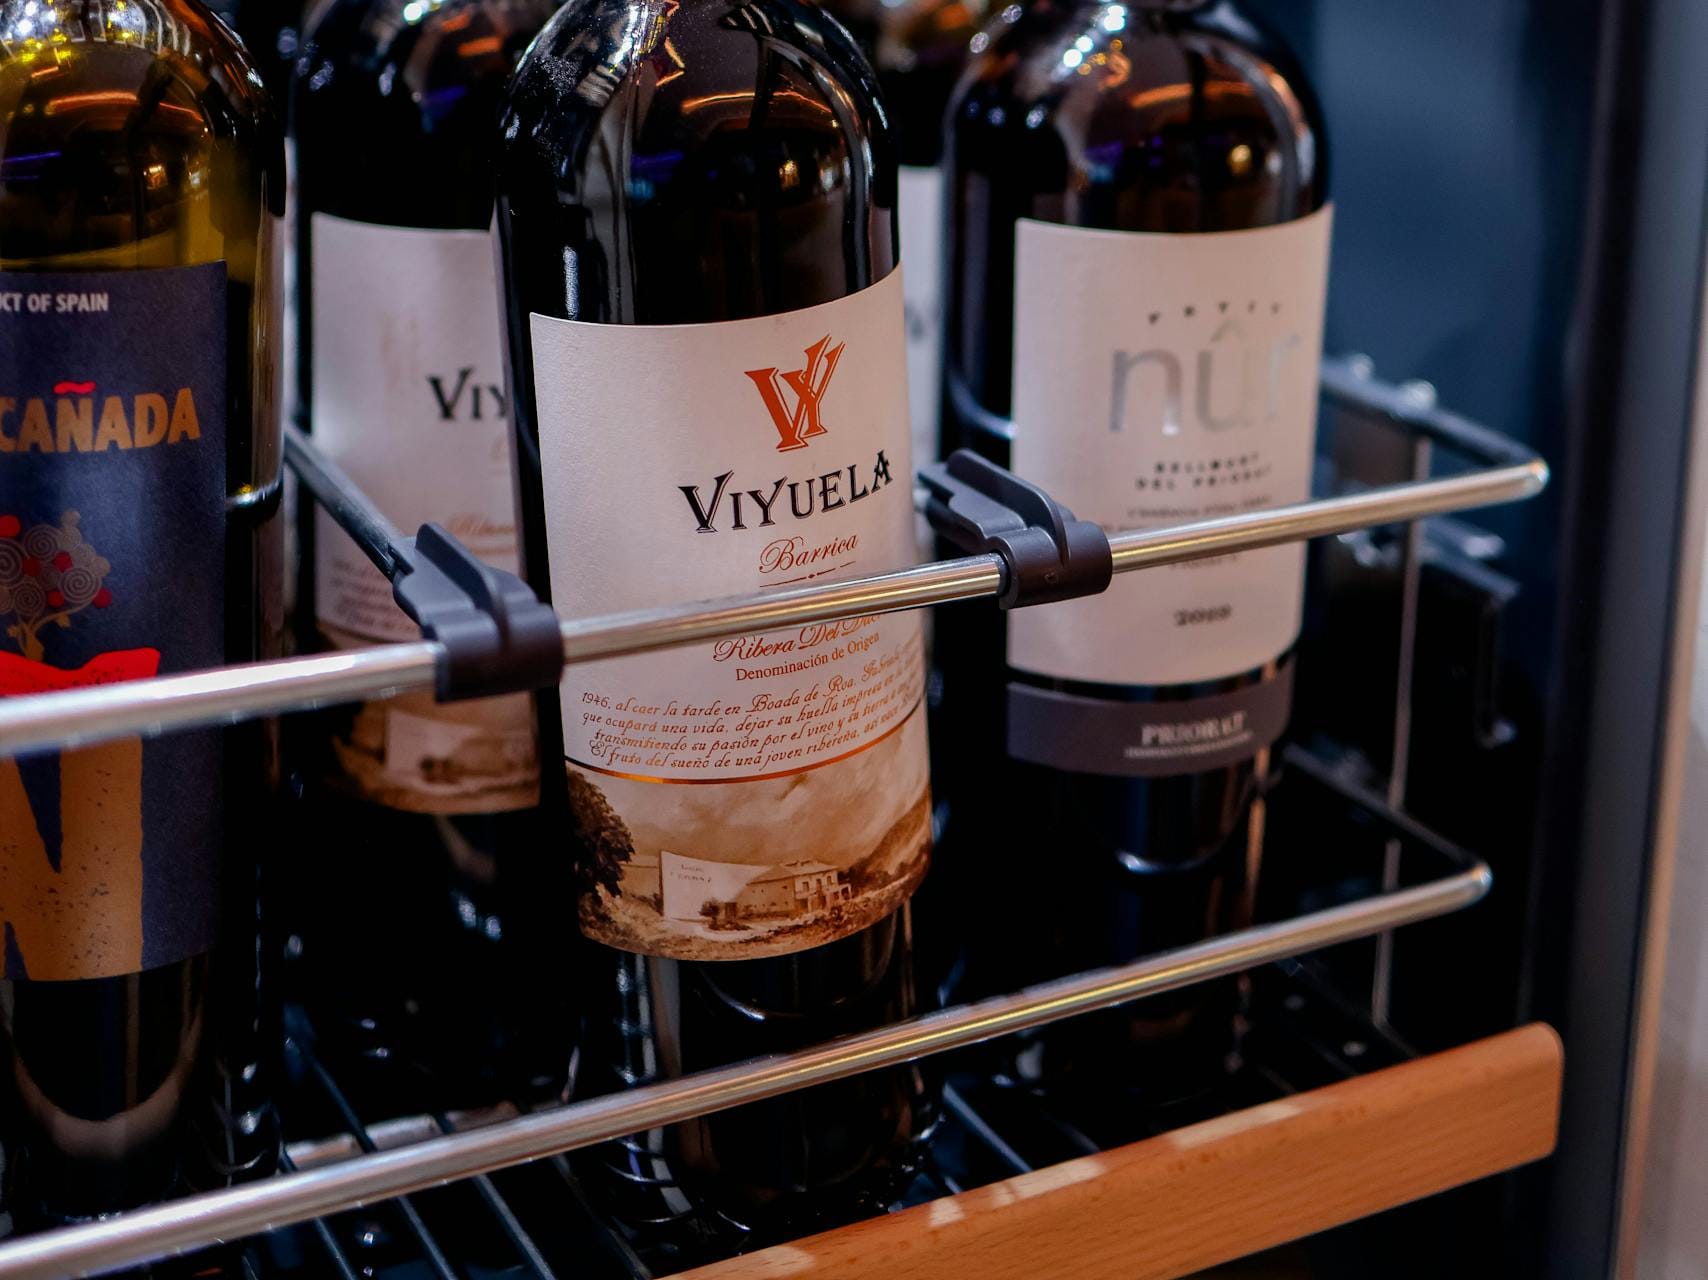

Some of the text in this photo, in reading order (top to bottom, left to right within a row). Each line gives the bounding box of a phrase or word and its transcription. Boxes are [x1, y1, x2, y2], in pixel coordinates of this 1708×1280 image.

[0, 292, 109, 313] CT OF SPAIN
[0, 380, 201, 454] CAÑADA
[758, 533, 859, 574] Barrica
[712, 633, 795, 662] Ribera
[797, 623, 839, 650] Del
[735, 651, 828, 682] Denominación
[831, 646, 845, 662] de
[847, 632, 880, 655] Origen
[583, 712, 600, 726] que
[661, 725, 688, 734] una
[735, 714, 774, 738] dejar
[777, 714, 792, 726] su
[796, 694, 839, 722] huella
[632, 705, 660, 716] caer
[662, 700, 678, 716] la
[681, 700, 721, 717] tarde
[724, 705, 741, 716] en
[745, 688, 800, 713] Boada
[803, 683, 820, 702] de
[594, 728, 688, 751] transmitiendo
[691, 741, 706, 751] su
[757, 734, 788, 754] por
[790, 720, 812, 741] el
[807, 720, 834, 737] vino
[606, 746, 641, 766] fruto
[644, 752, 675, 767] del
[714, 751, 732, 768] de
[735, 756, 762, 767] una
[758, 748, 803, 772] joven
